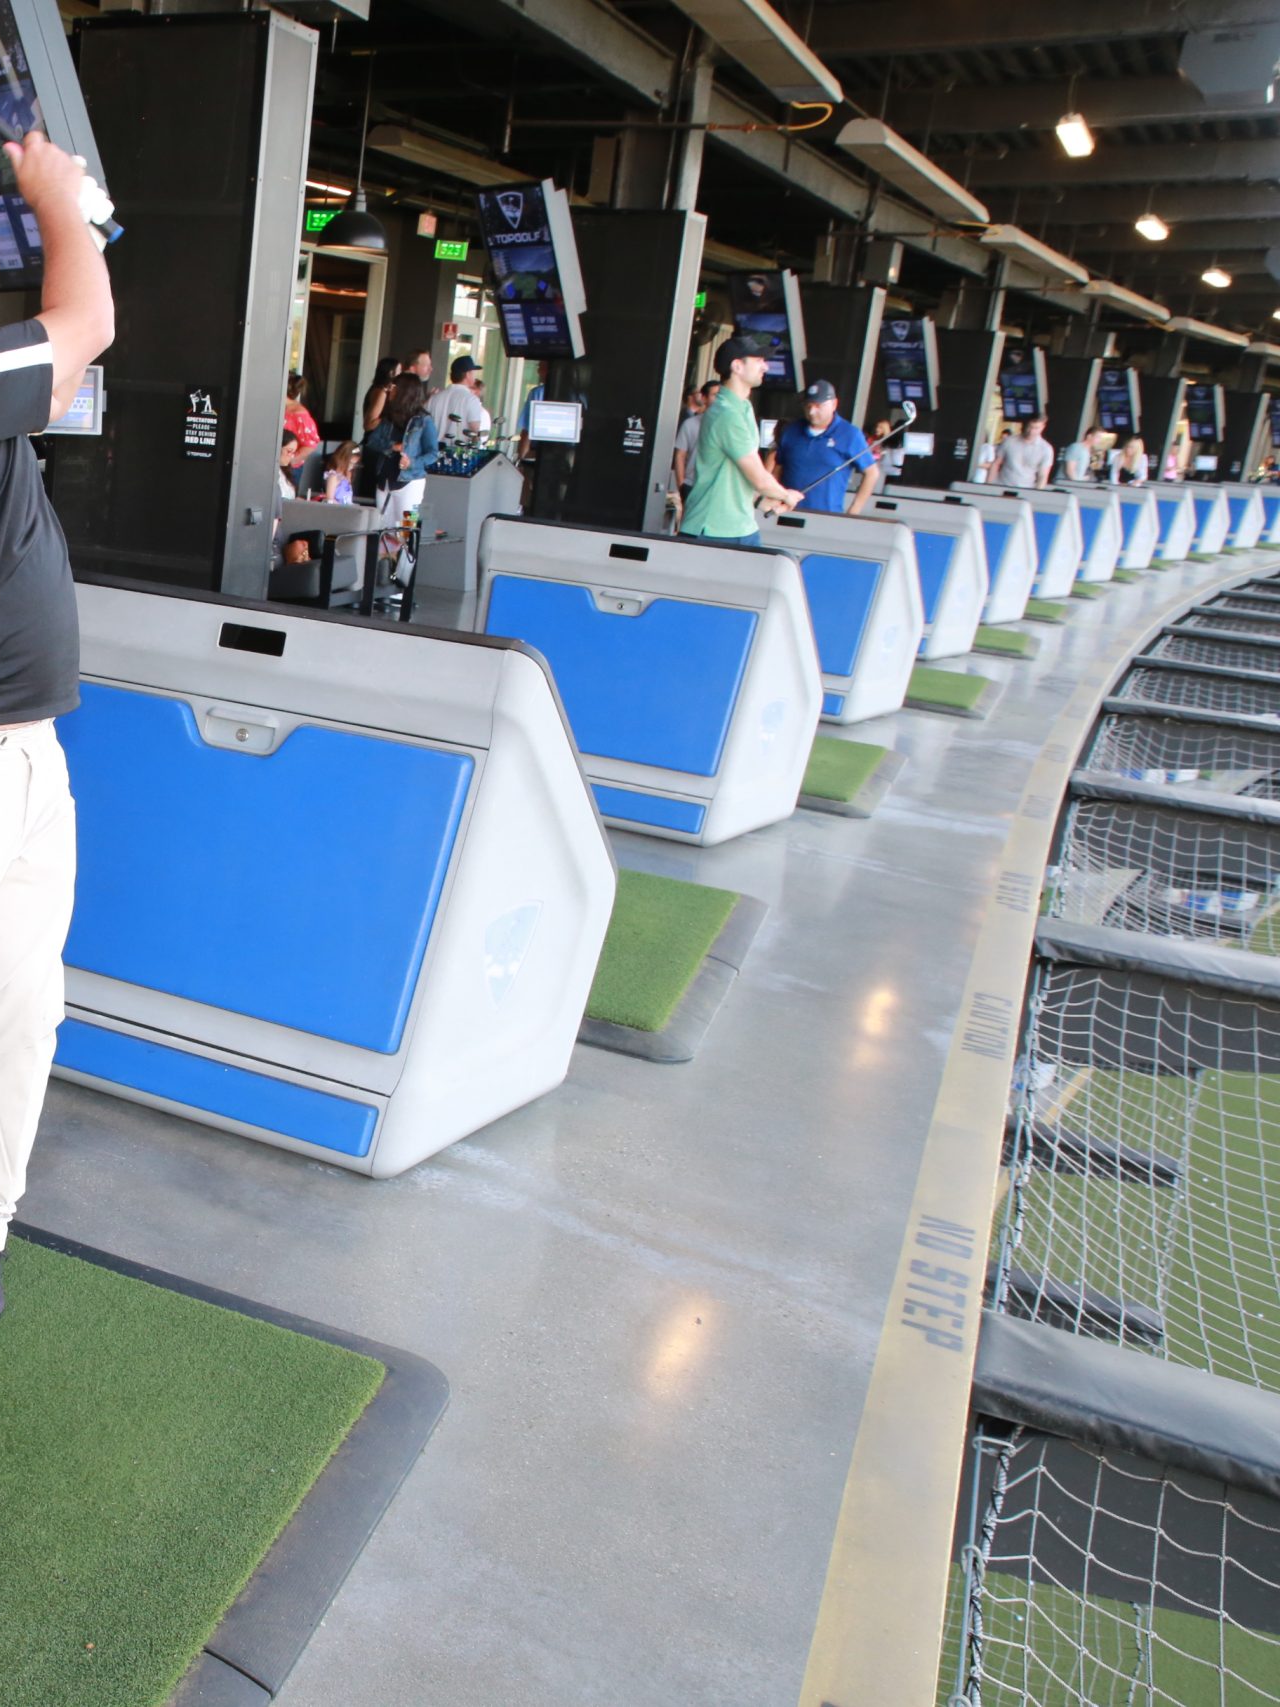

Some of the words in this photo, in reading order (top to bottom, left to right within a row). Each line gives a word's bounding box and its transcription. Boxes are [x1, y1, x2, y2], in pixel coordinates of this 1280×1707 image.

[312, 213, 335, 226] 32
[495, 231, 541, 244] TOPGOLF
[186, 416, 218, 425] SPECTATORS
[184, 436, 199, 444] RED
[200, 437, 216, 446] LINE
[961, 992, 1013, 1060] CAUTION
[915, 1214, 976, 1260] NO
[901, 1259, 970, 1352] STEP
